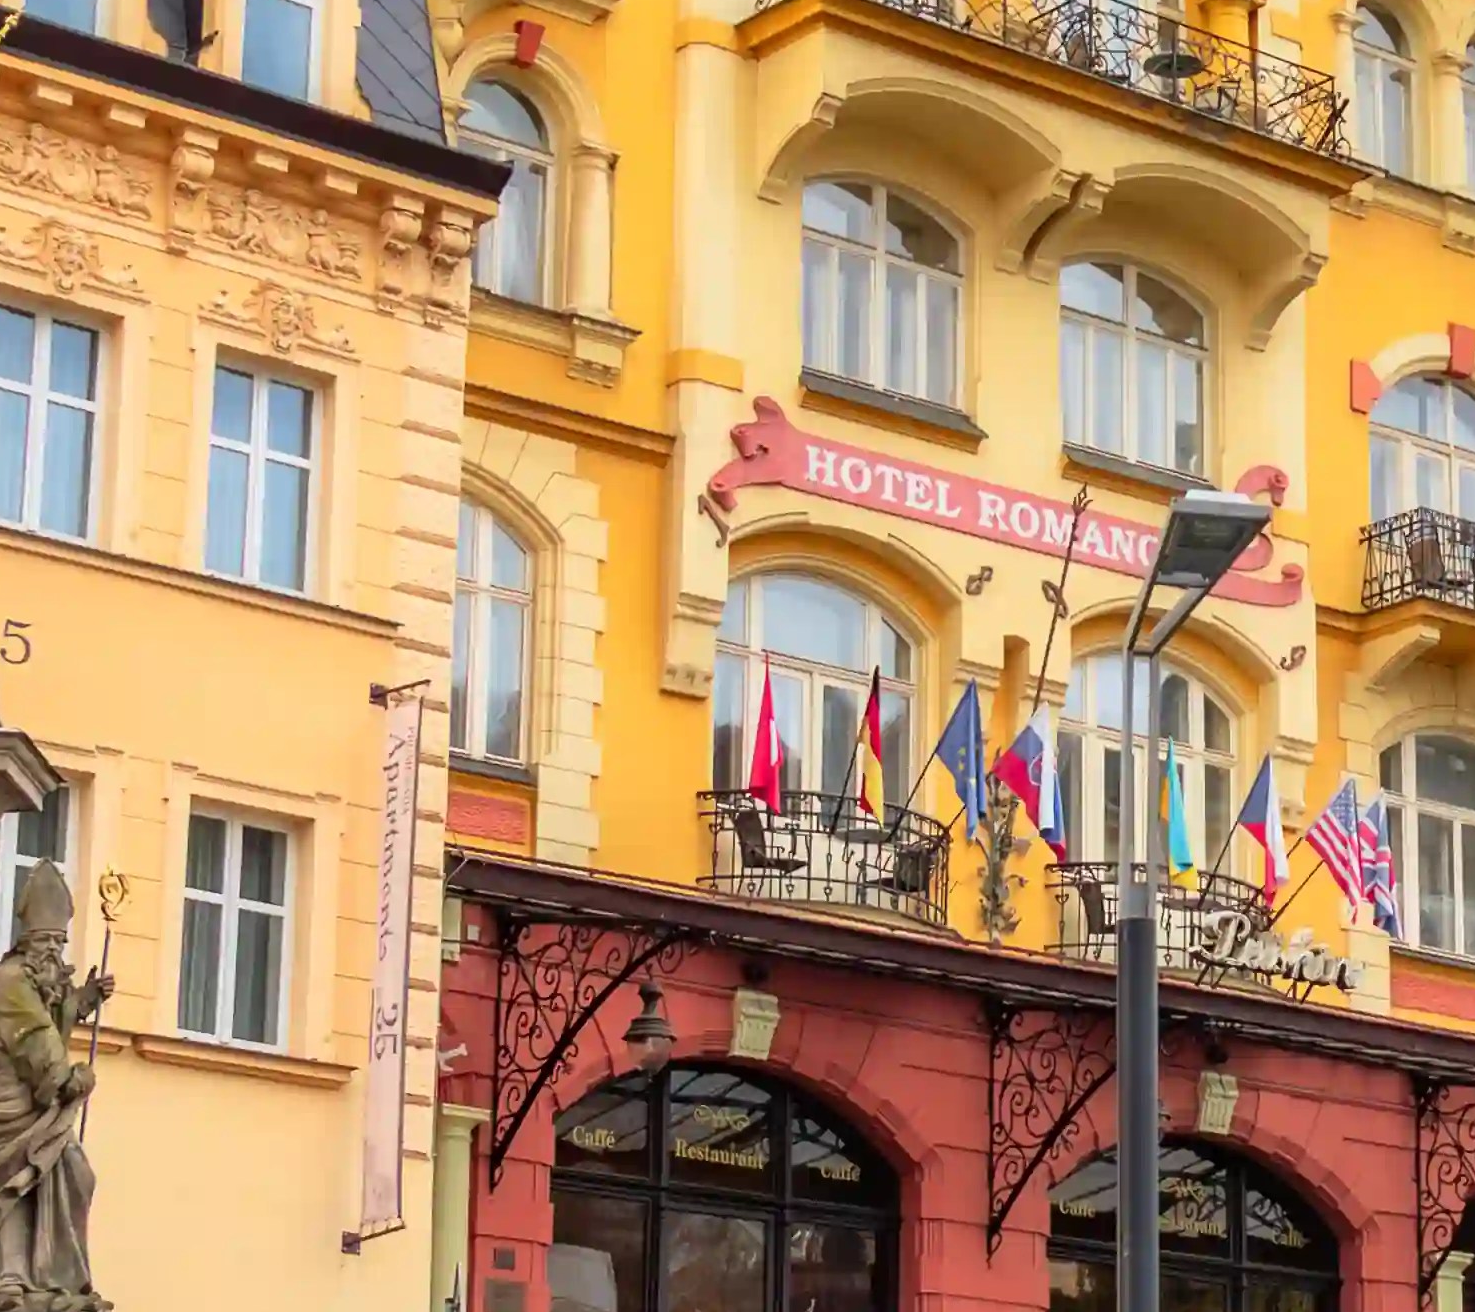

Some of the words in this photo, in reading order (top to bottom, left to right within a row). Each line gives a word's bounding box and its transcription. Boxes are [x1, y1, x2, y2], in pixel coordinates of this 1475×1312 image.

[806, 445, 962, 518] HOTEL
[977, 490, 1159, 569] ROMANC
[675, 1138, 765, 1170] Restaurant
